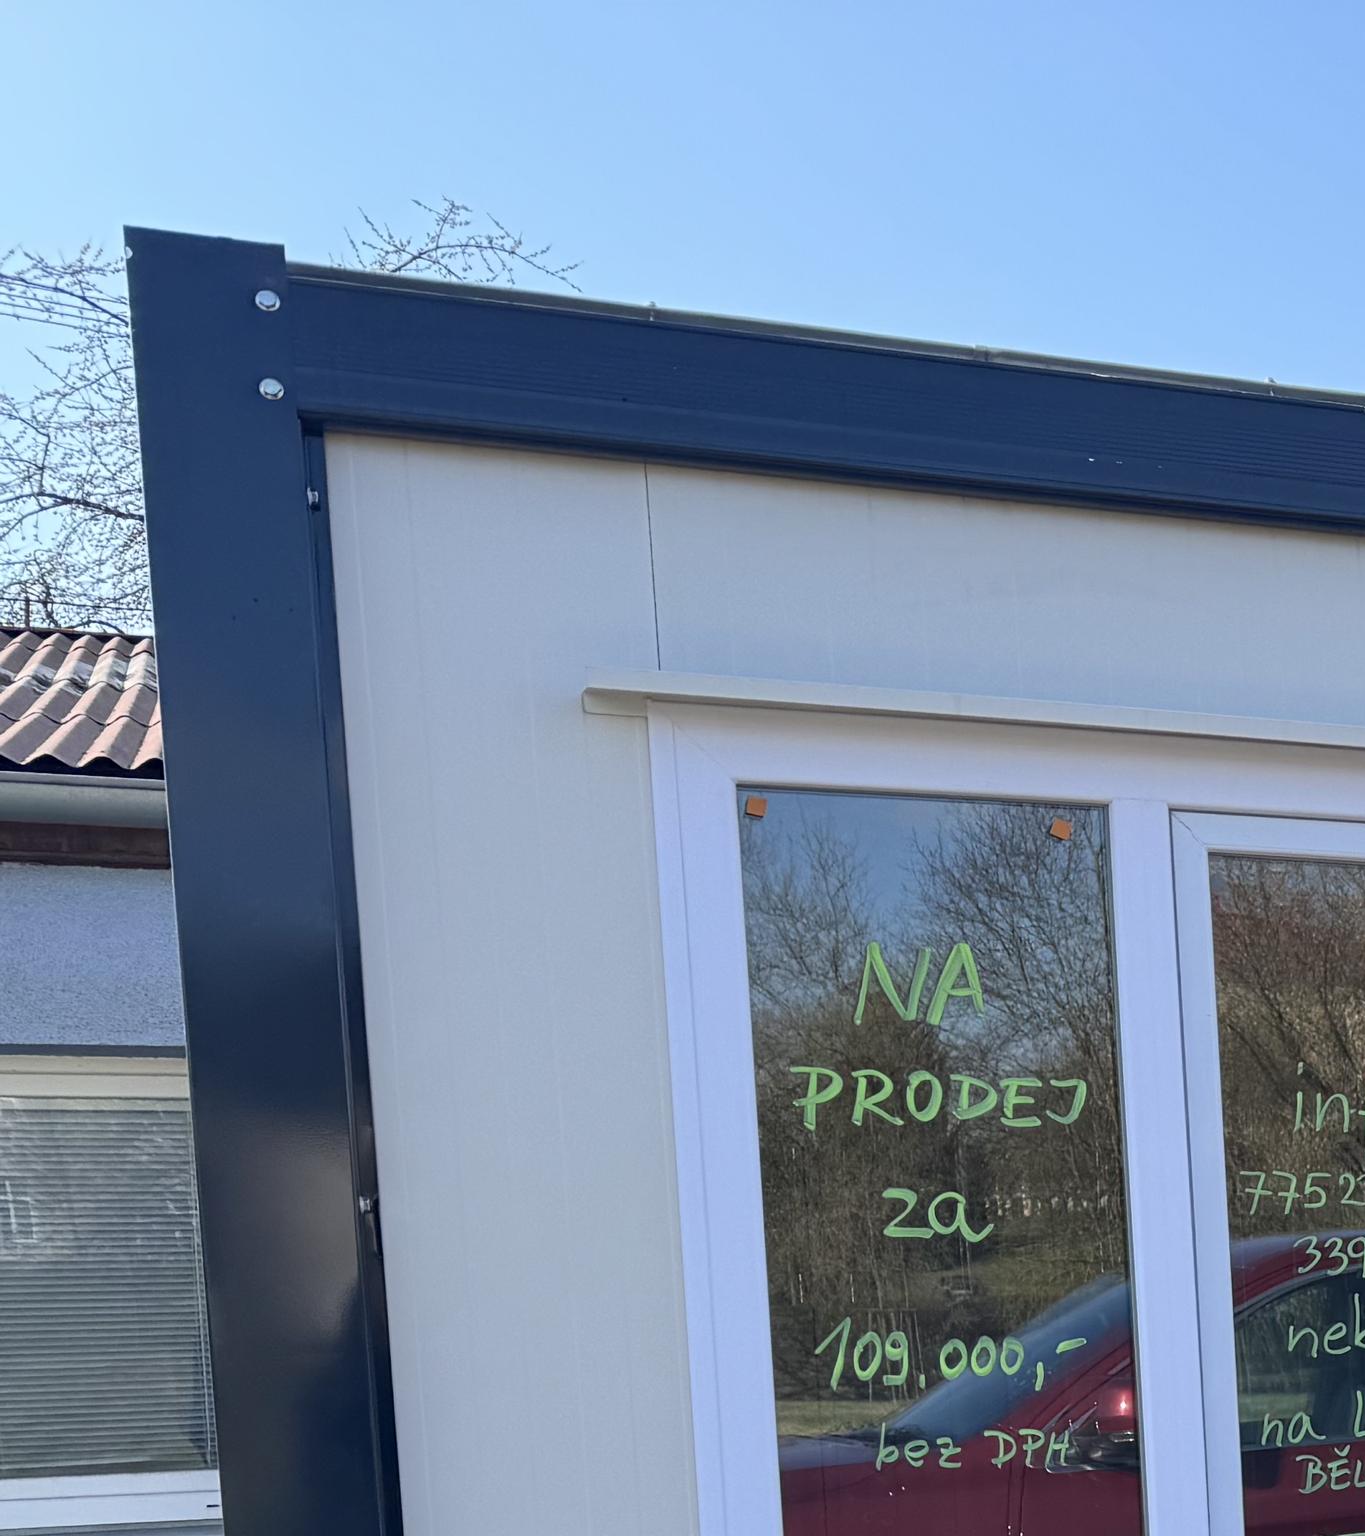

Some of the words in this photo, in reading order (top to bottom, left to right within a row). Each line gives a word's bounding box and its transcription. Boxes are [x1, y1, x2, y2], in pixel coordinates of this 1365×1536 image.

[853, 941, 986, 1026] NA
[789, 1066, 1087, 1131] PRODEJ
[875, 1422, 962, 1472] bez
[983, 1428, 1069, 1469] DPH
[1261, 1411, 1326, 1447] na
